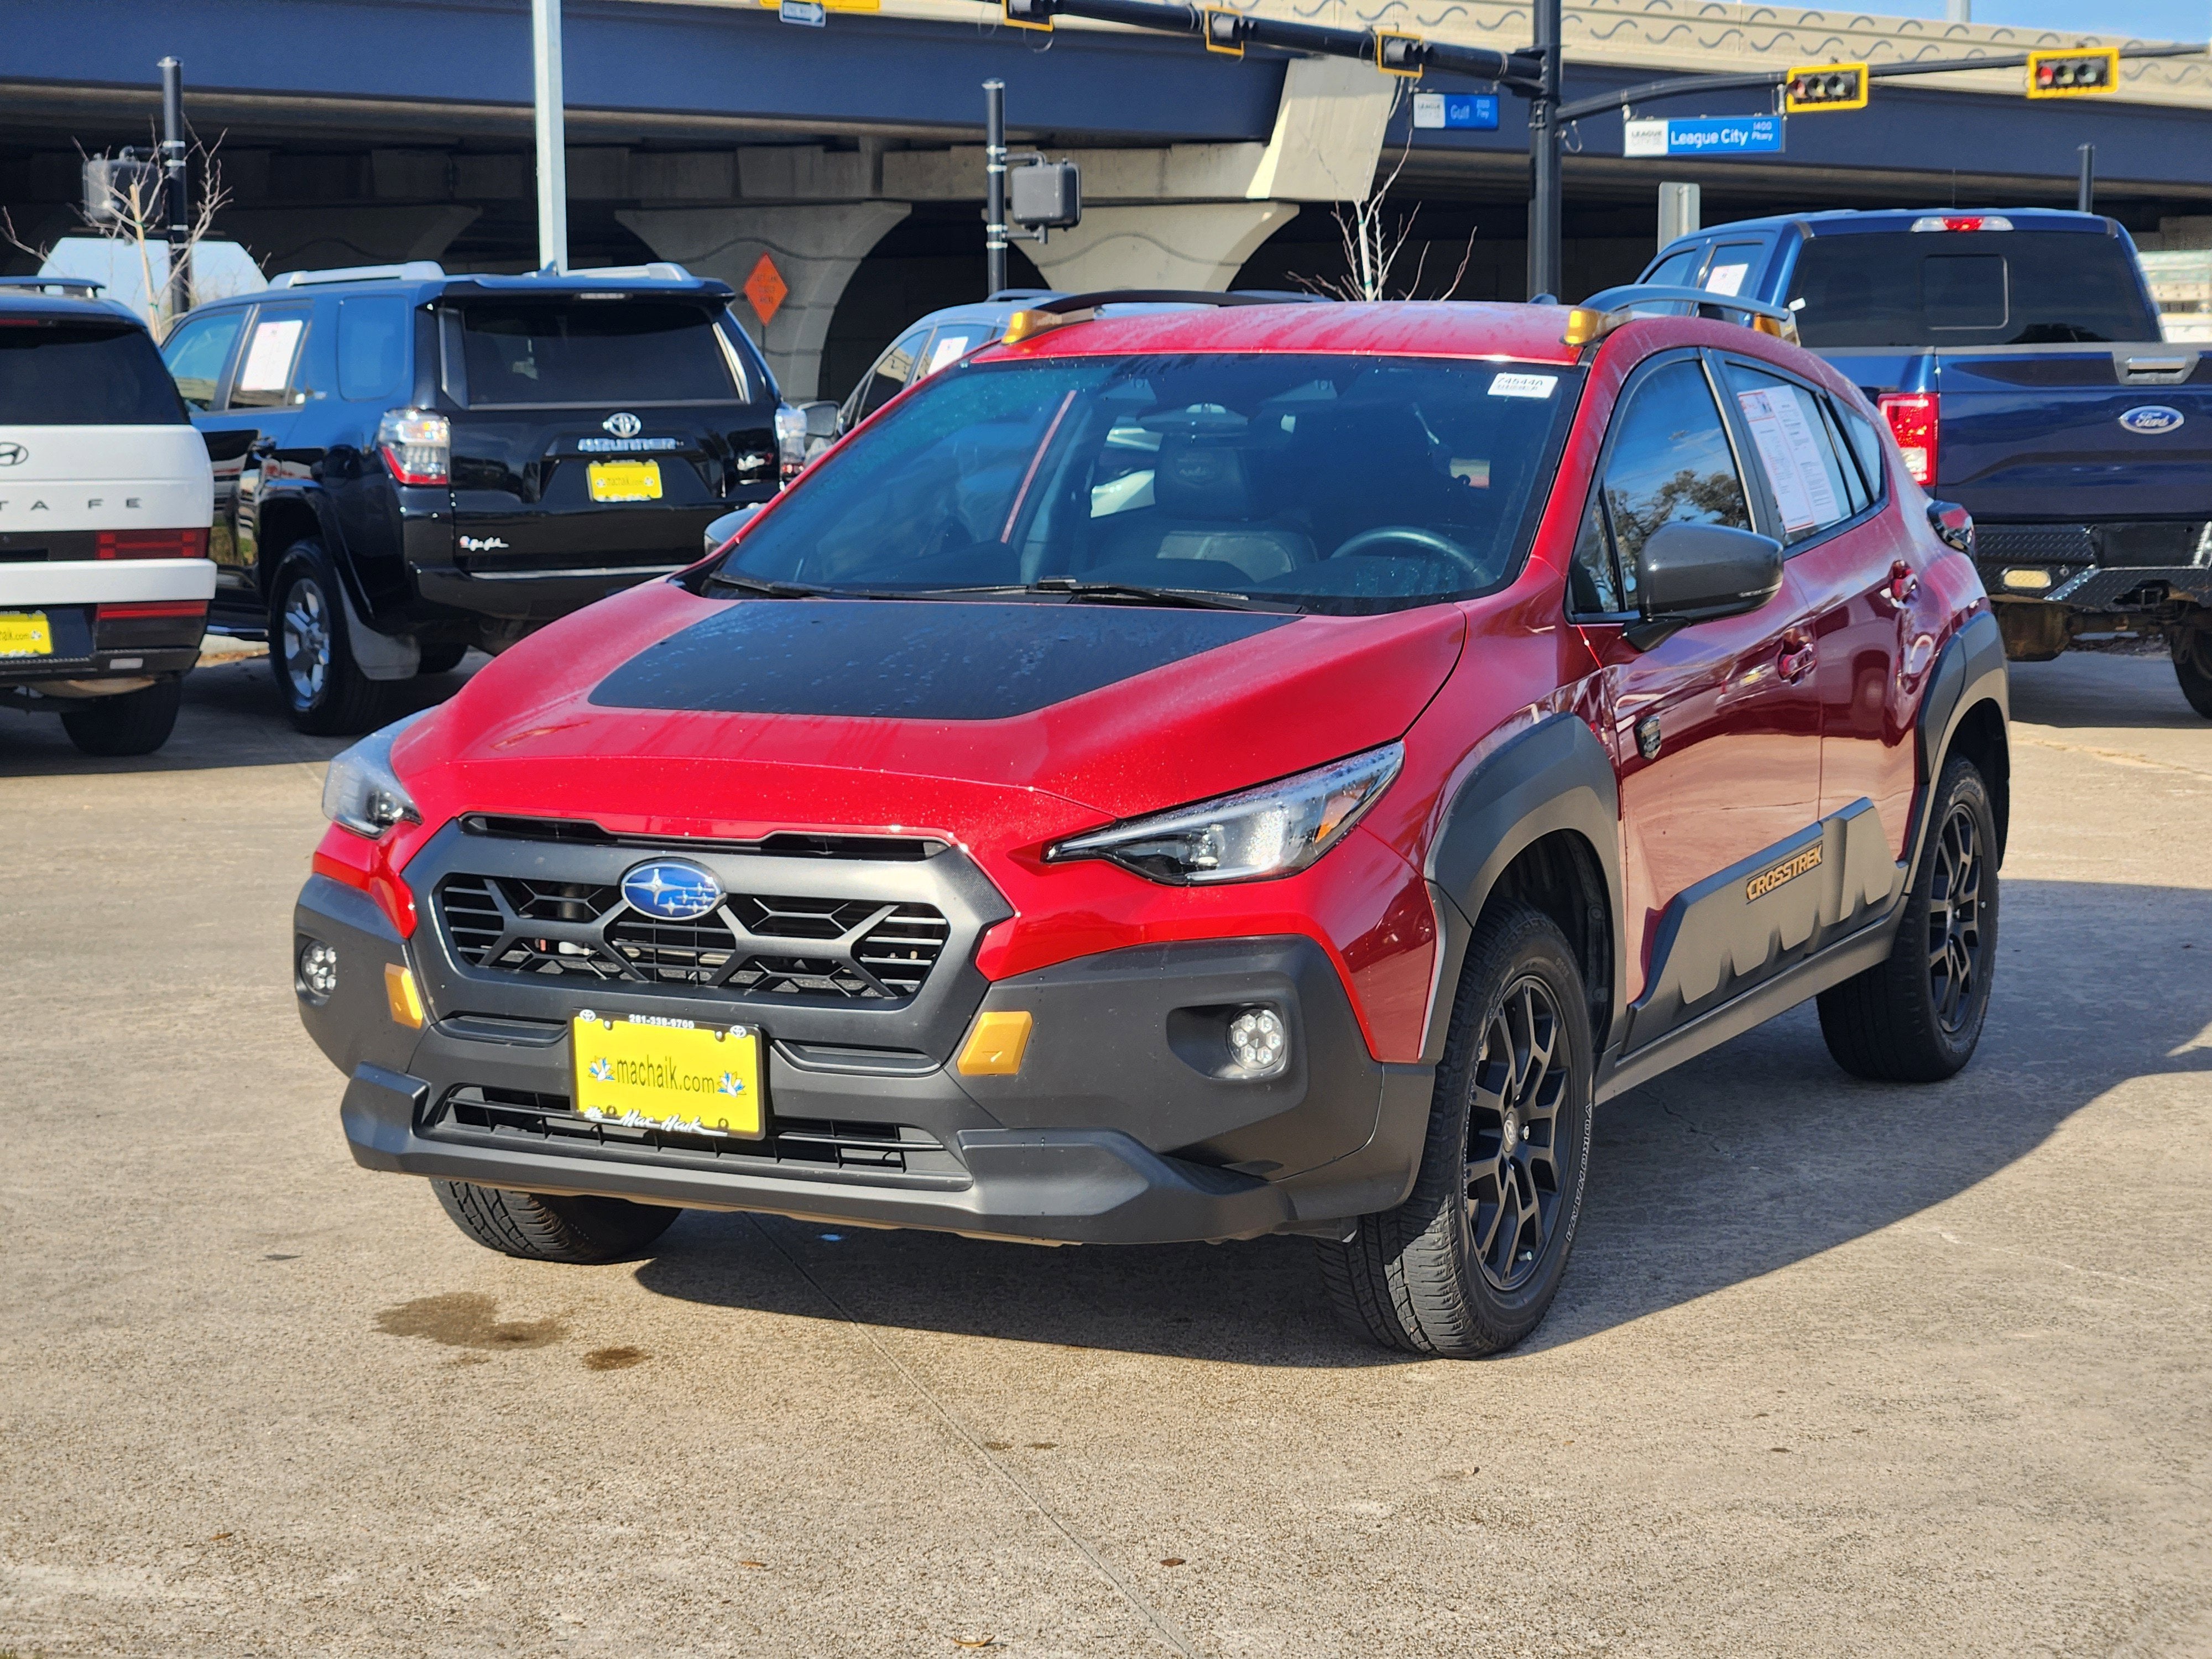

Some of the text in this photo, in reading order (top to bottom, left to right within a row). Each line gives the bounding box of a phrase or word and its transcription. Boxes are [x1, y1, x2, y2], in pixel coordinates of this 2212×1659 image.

[1671, 131, 1719, 149] League
[1720, 128, 1749, 146] City
[2135, 411, 2169, 427] Ford
[1746, 844, 1823, 900] CROSSTREK
[628, 1014, 695, 1029] 281-338-9700
[617, 1054, 715, 1094] machaik.com
[1566, 1103, 1592, 1242] YOKOHAMA
